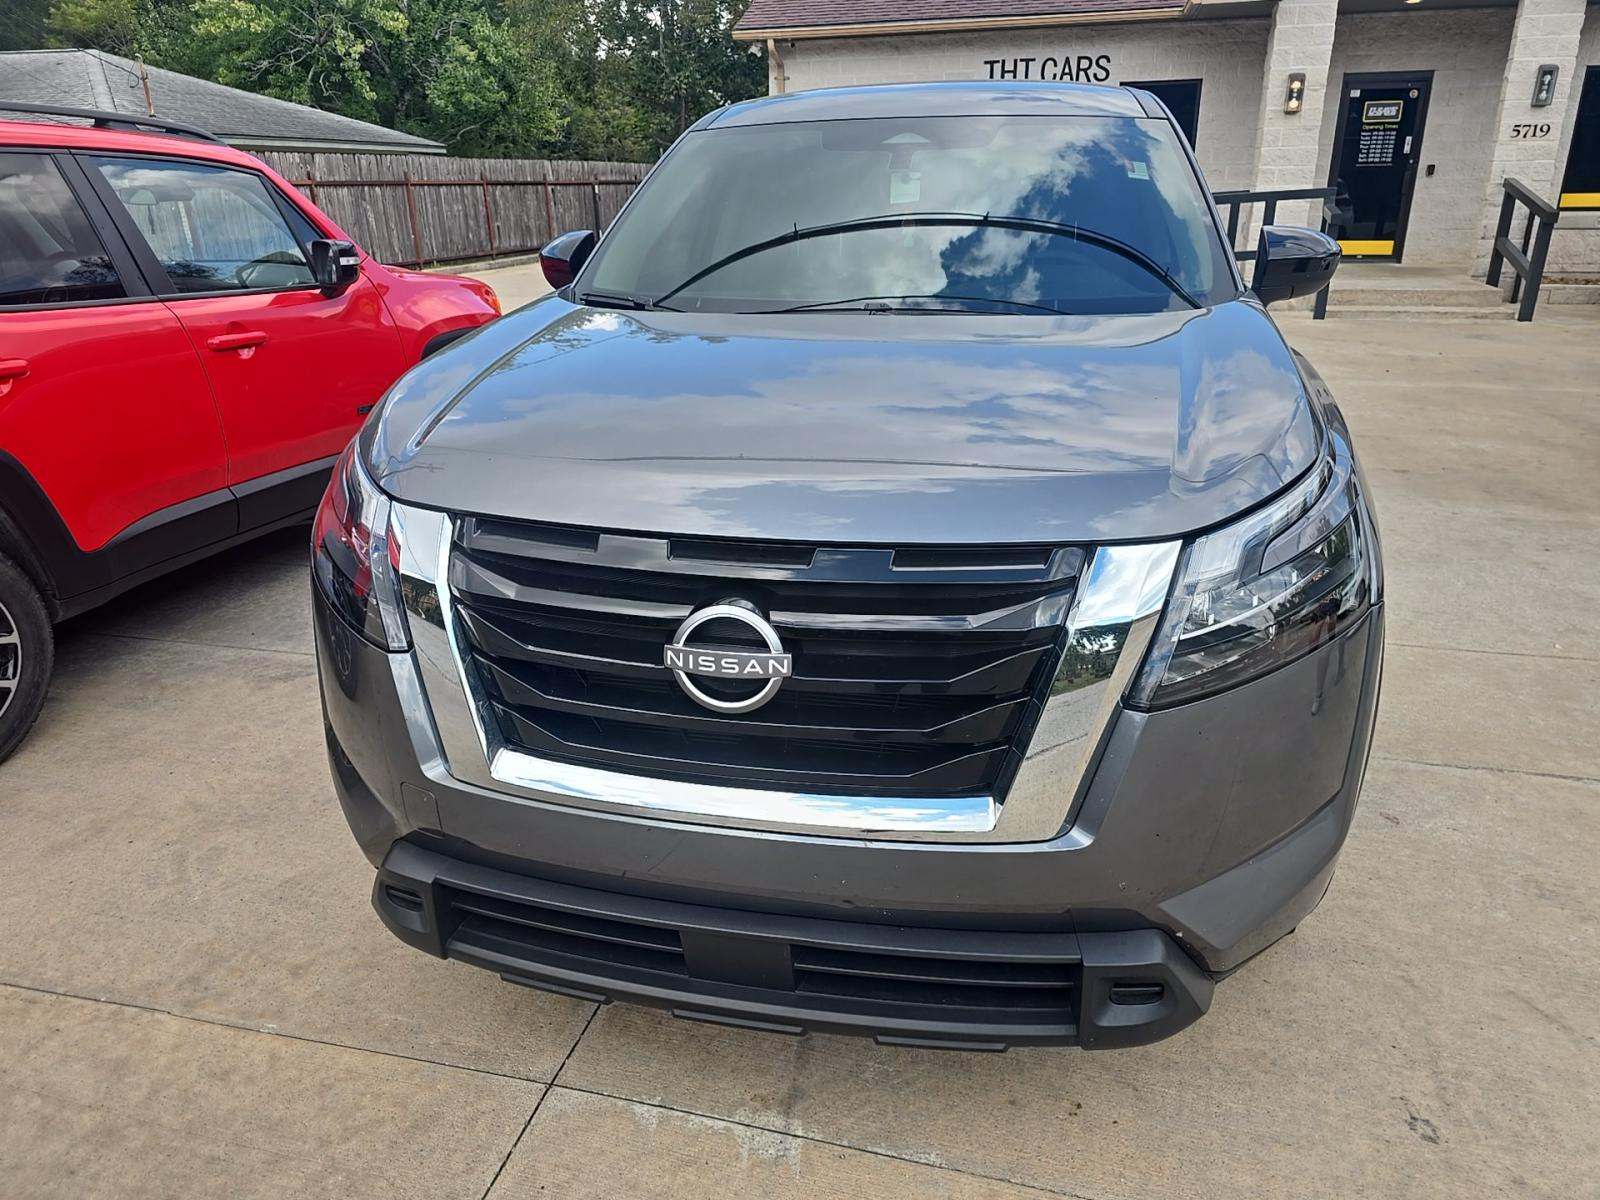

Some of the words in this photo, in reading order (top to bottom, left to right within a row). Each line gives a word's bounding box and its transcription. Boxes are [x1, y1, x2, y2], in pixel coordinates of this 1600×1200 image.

[984, 58, 1036, 80] THT
[1040, 55, 1111, 83] CARS
[1510, 123, 1552, 139] 5719
[666, 650, 788, 675] NISSAN
